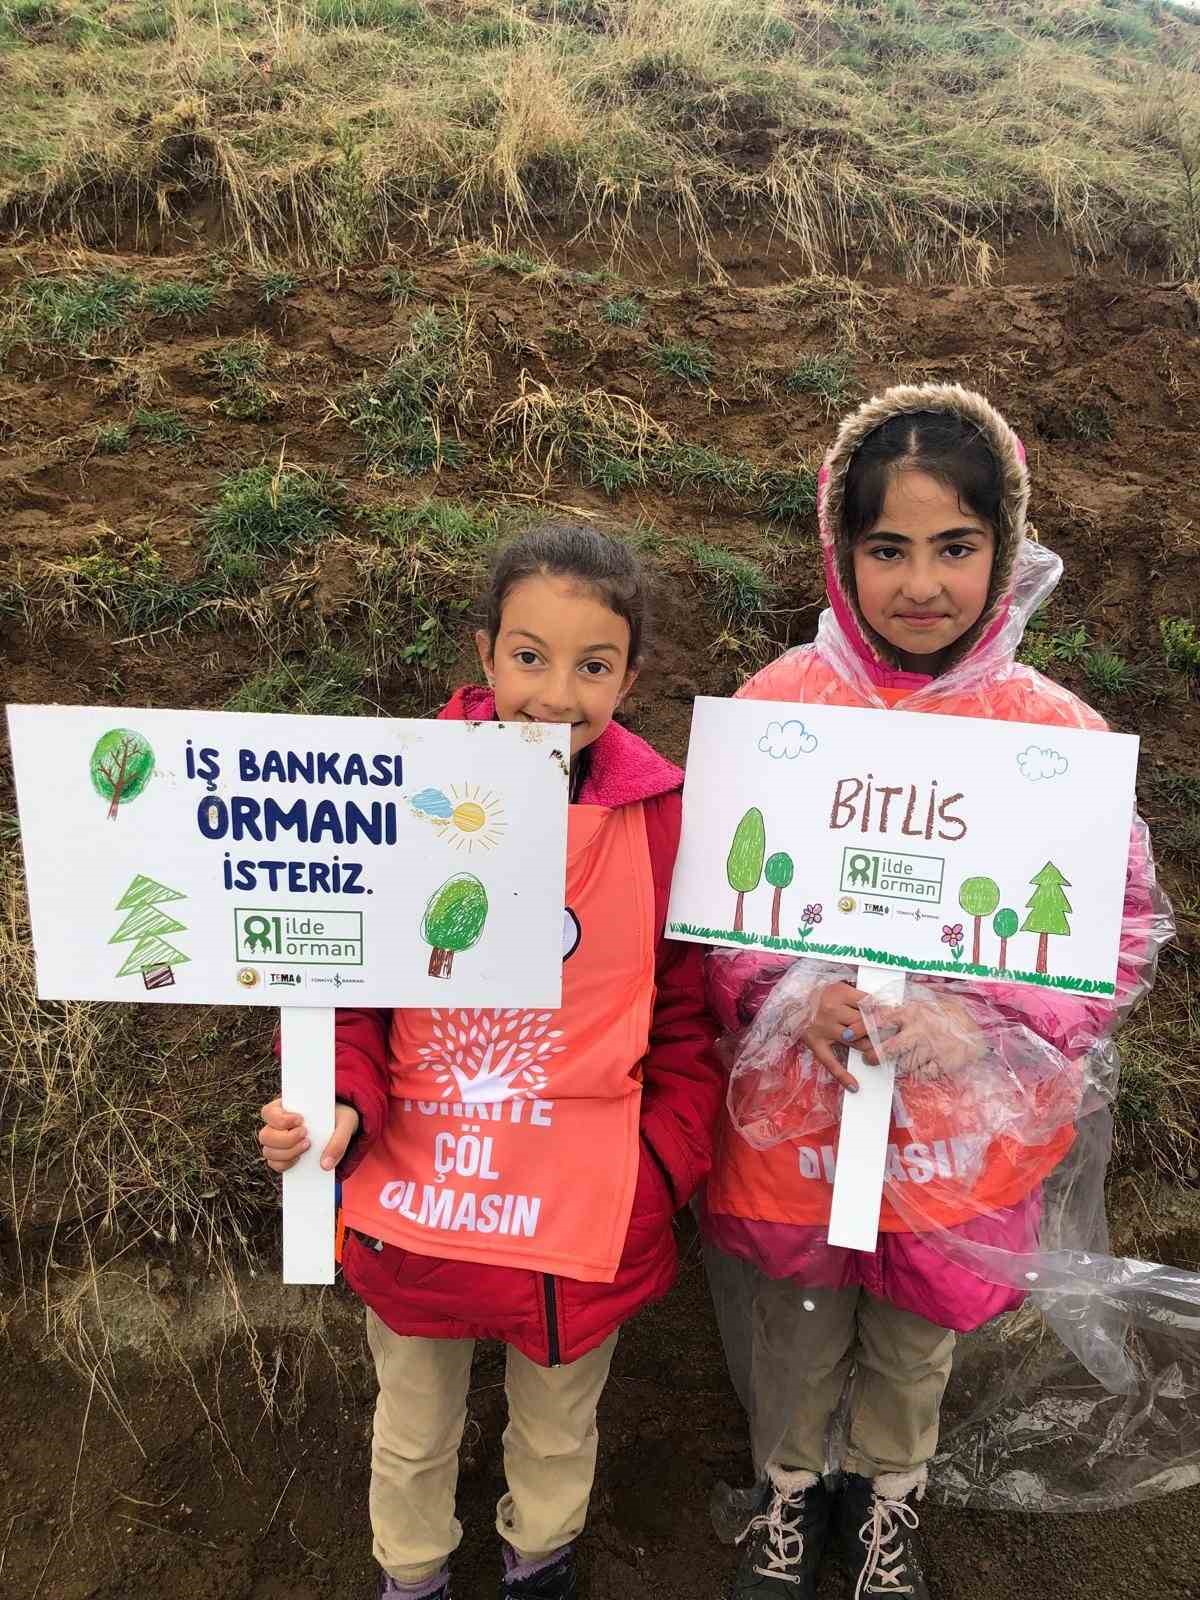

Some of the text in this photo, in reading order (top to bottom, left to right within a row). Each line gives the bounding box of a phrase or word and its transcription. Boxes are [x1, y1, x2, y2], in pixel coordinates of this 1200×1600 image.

[186, 739, 403, 791] İŞ BANKASI
[197, 796, 397, 845] ORMANI
[830, 773, 967, 841] BİTLİS
[224, 852, 374, 894] İSTERİZ.
[880, 879, 936, 897] orman
[882, 858, 913, 875] ilde
[286, 917, 325, 935] ilde
[286, 942, 356, 956] orman
[434, 1124, 499, 1182] ÇÖL
[379, 1180, 541, 1237] OLMASIN
